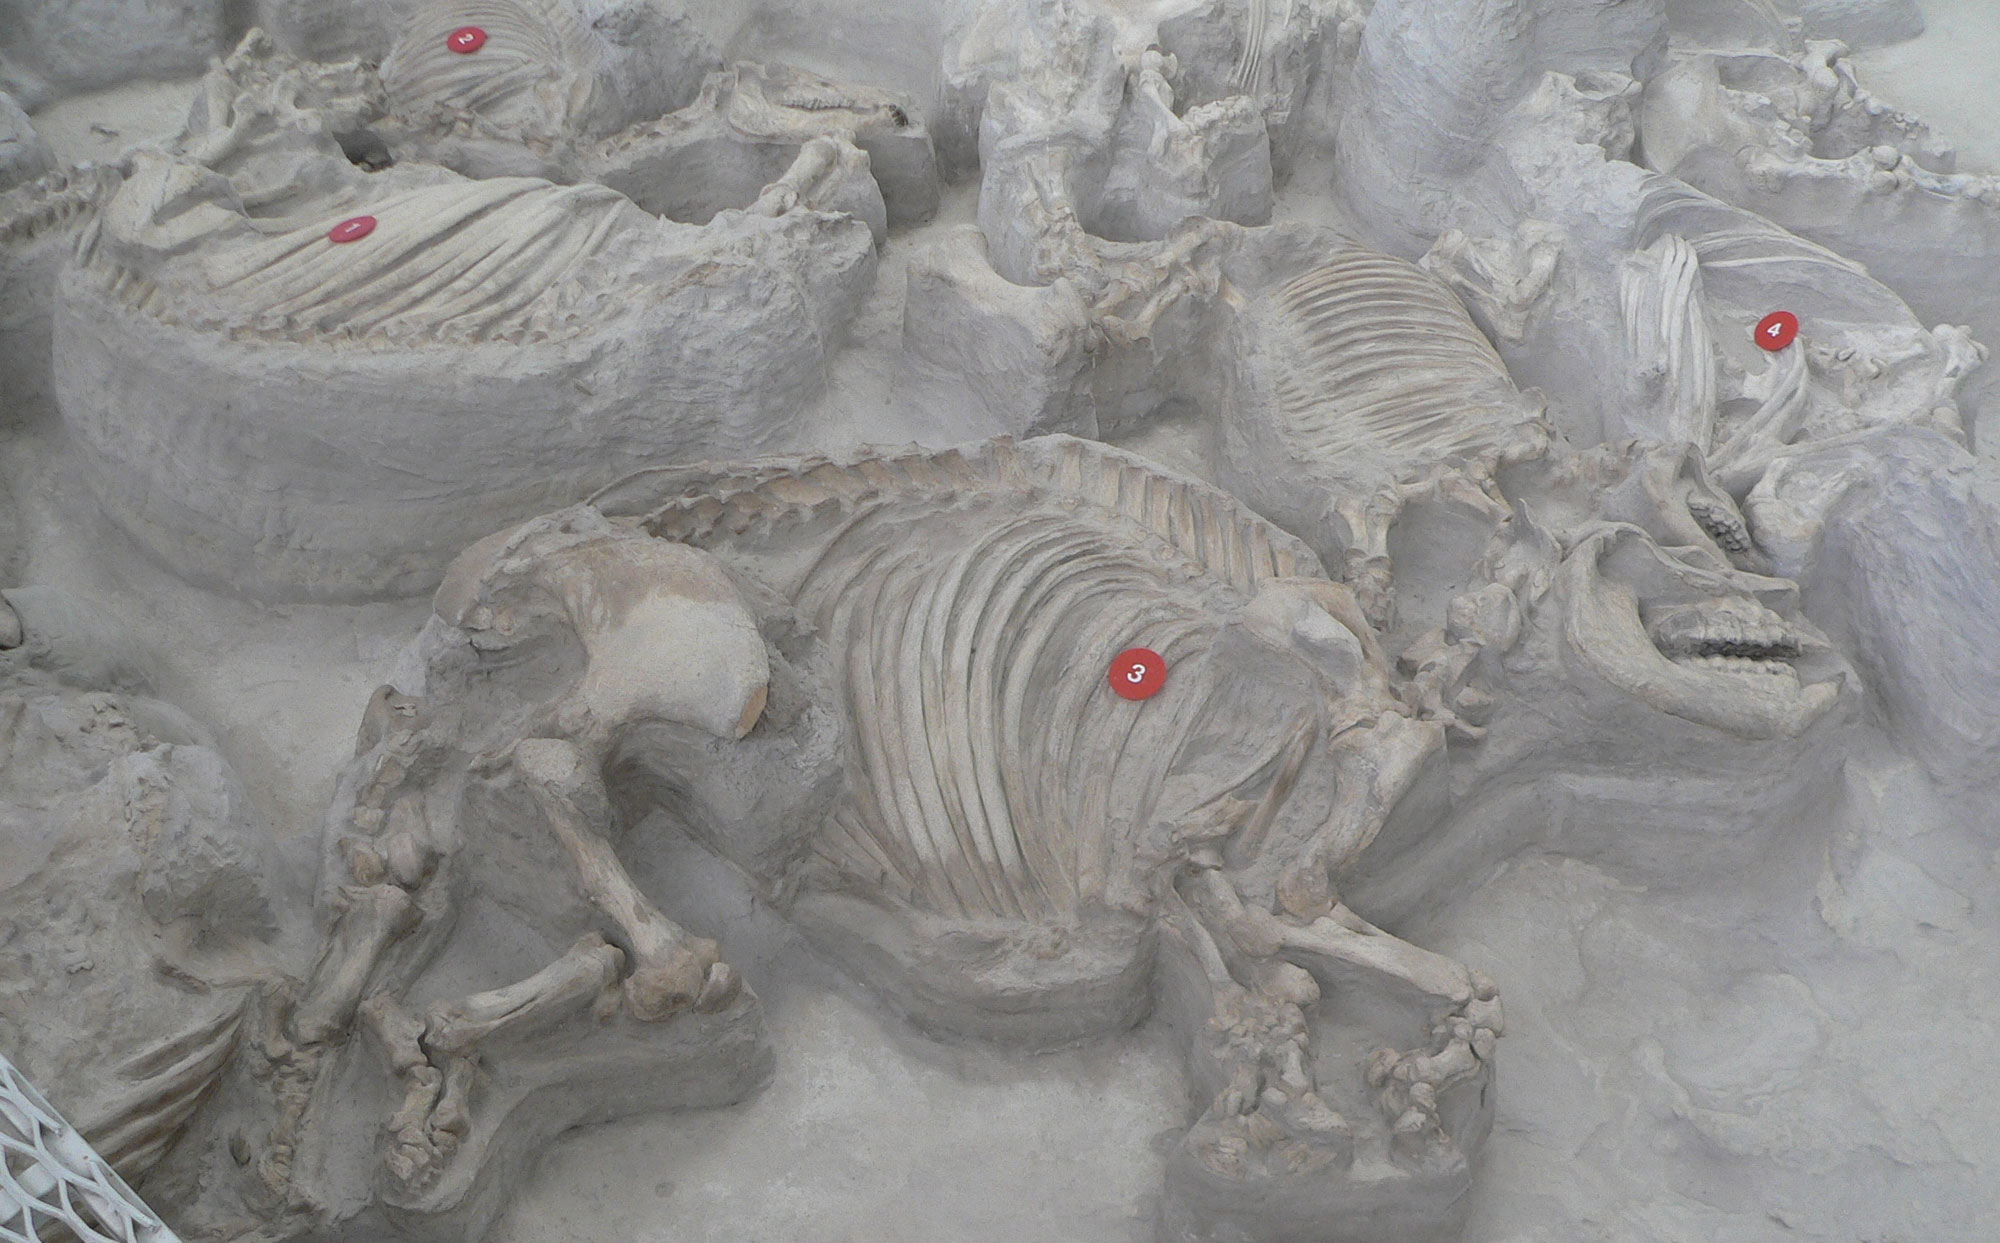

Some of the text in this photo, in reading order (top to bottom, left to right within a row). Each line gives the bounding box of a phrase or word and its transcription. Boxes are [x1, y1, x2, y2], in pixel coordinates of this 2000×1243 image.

[458, 33, 474, 45] 2
[345, 222, 361, 233] 1
[1767, 322, 1782, 337] 4
[1127, 663, 1146, 683] 3
